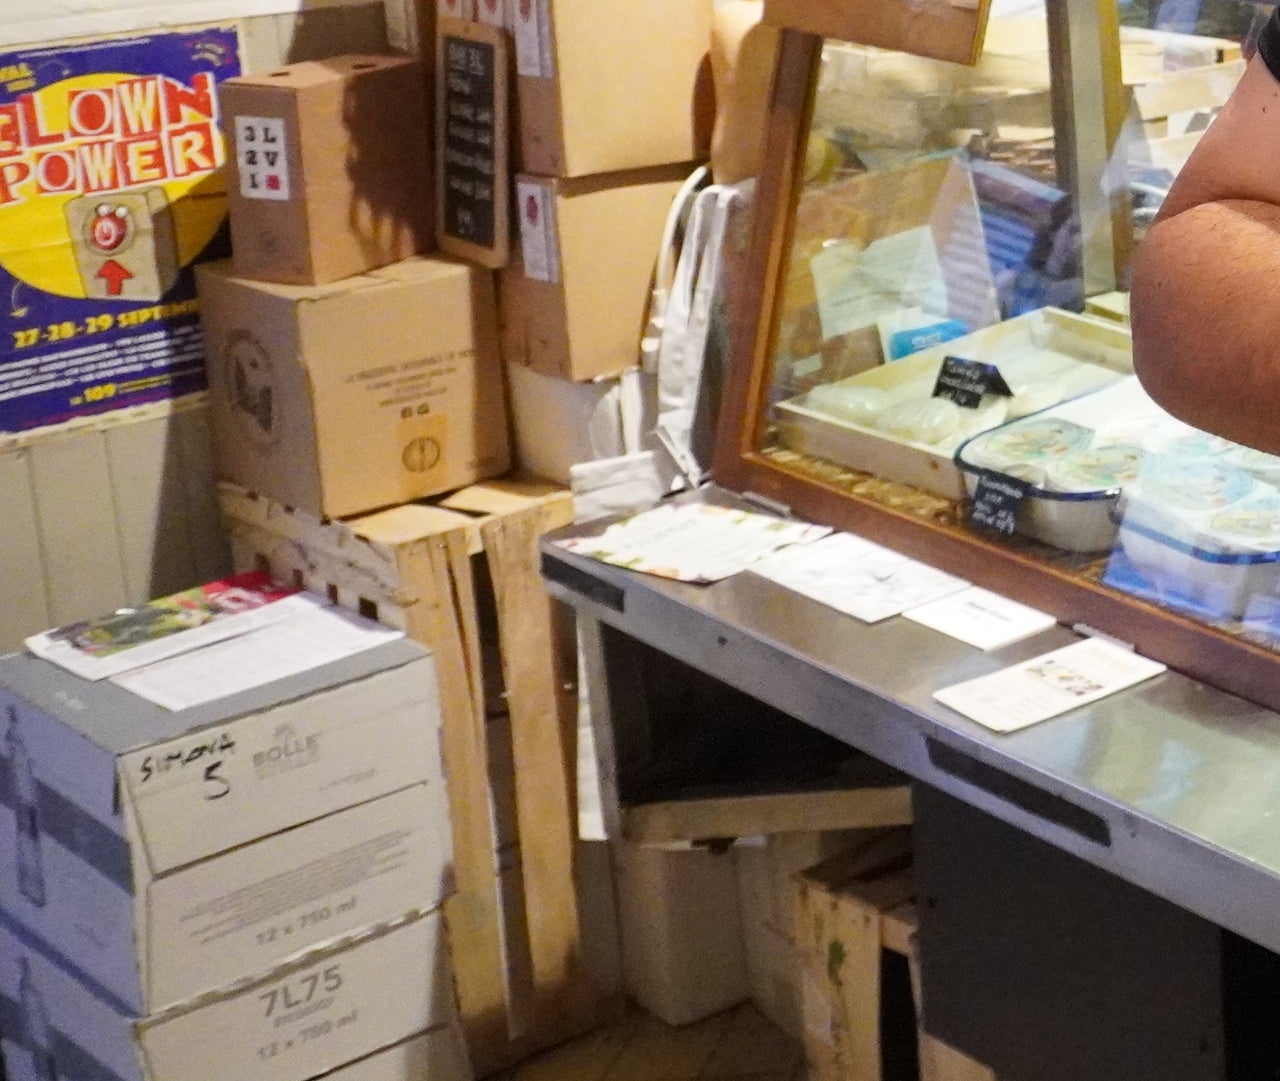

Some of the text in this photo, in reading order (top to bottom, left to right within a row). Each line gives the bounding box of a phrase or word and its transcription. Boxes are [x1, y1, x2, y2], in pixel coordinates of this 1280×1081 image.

[0, 124, 219, 205] POWER
[253, 733, 322, 766] BOLLE
[204, 761, 231, 800] 5
[258, 964, 344, 1018] 7L75
